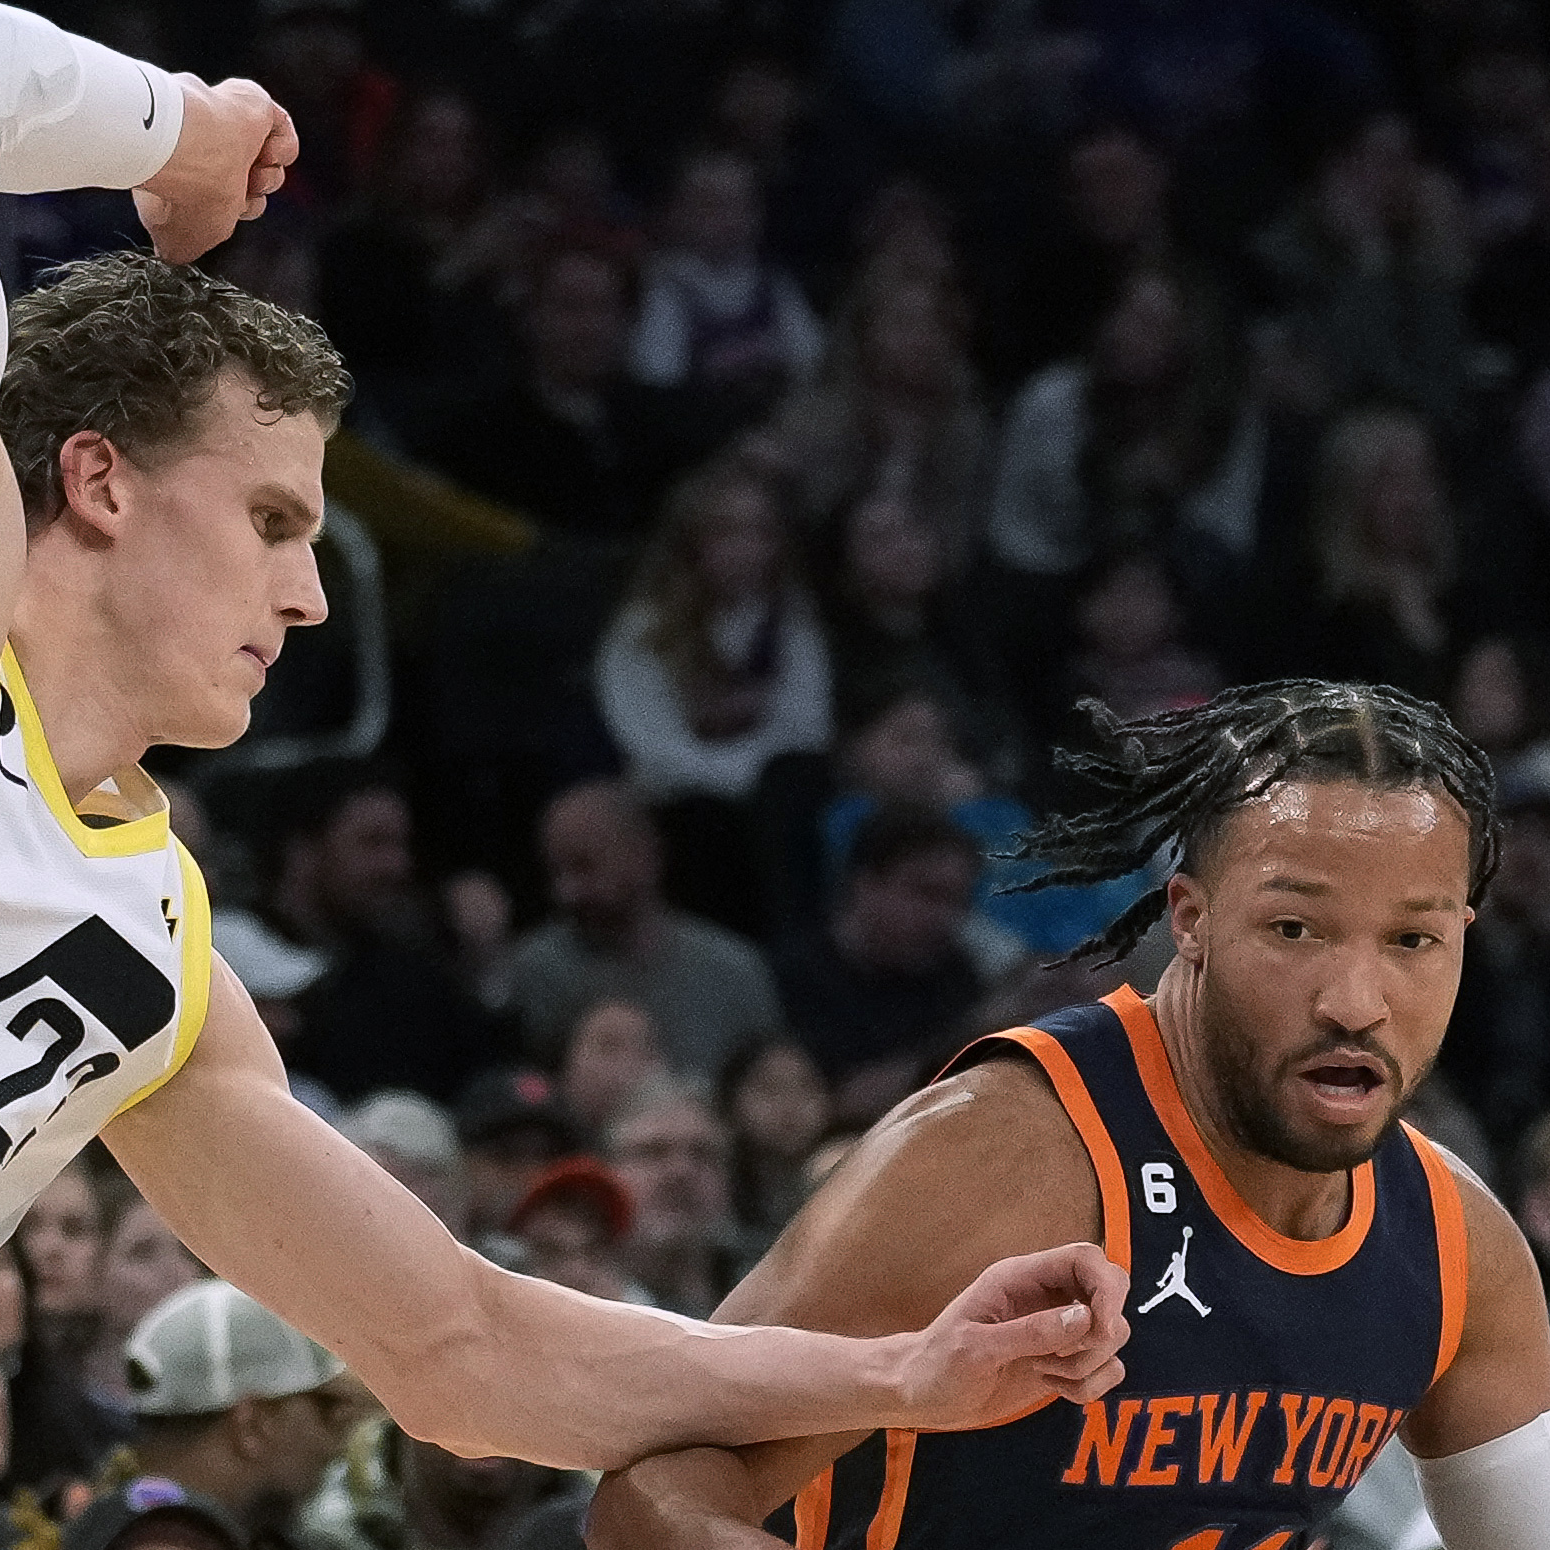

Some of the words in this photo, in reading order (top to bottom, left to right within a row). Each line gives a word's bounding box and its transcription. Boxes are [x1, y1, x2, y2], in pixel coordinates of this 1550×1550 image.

[1141, 1162, 1177, 1214] 6
[1061, 1391, 1267, 1486] NEW
[1272, 1392, 1407, 1488] YOR
